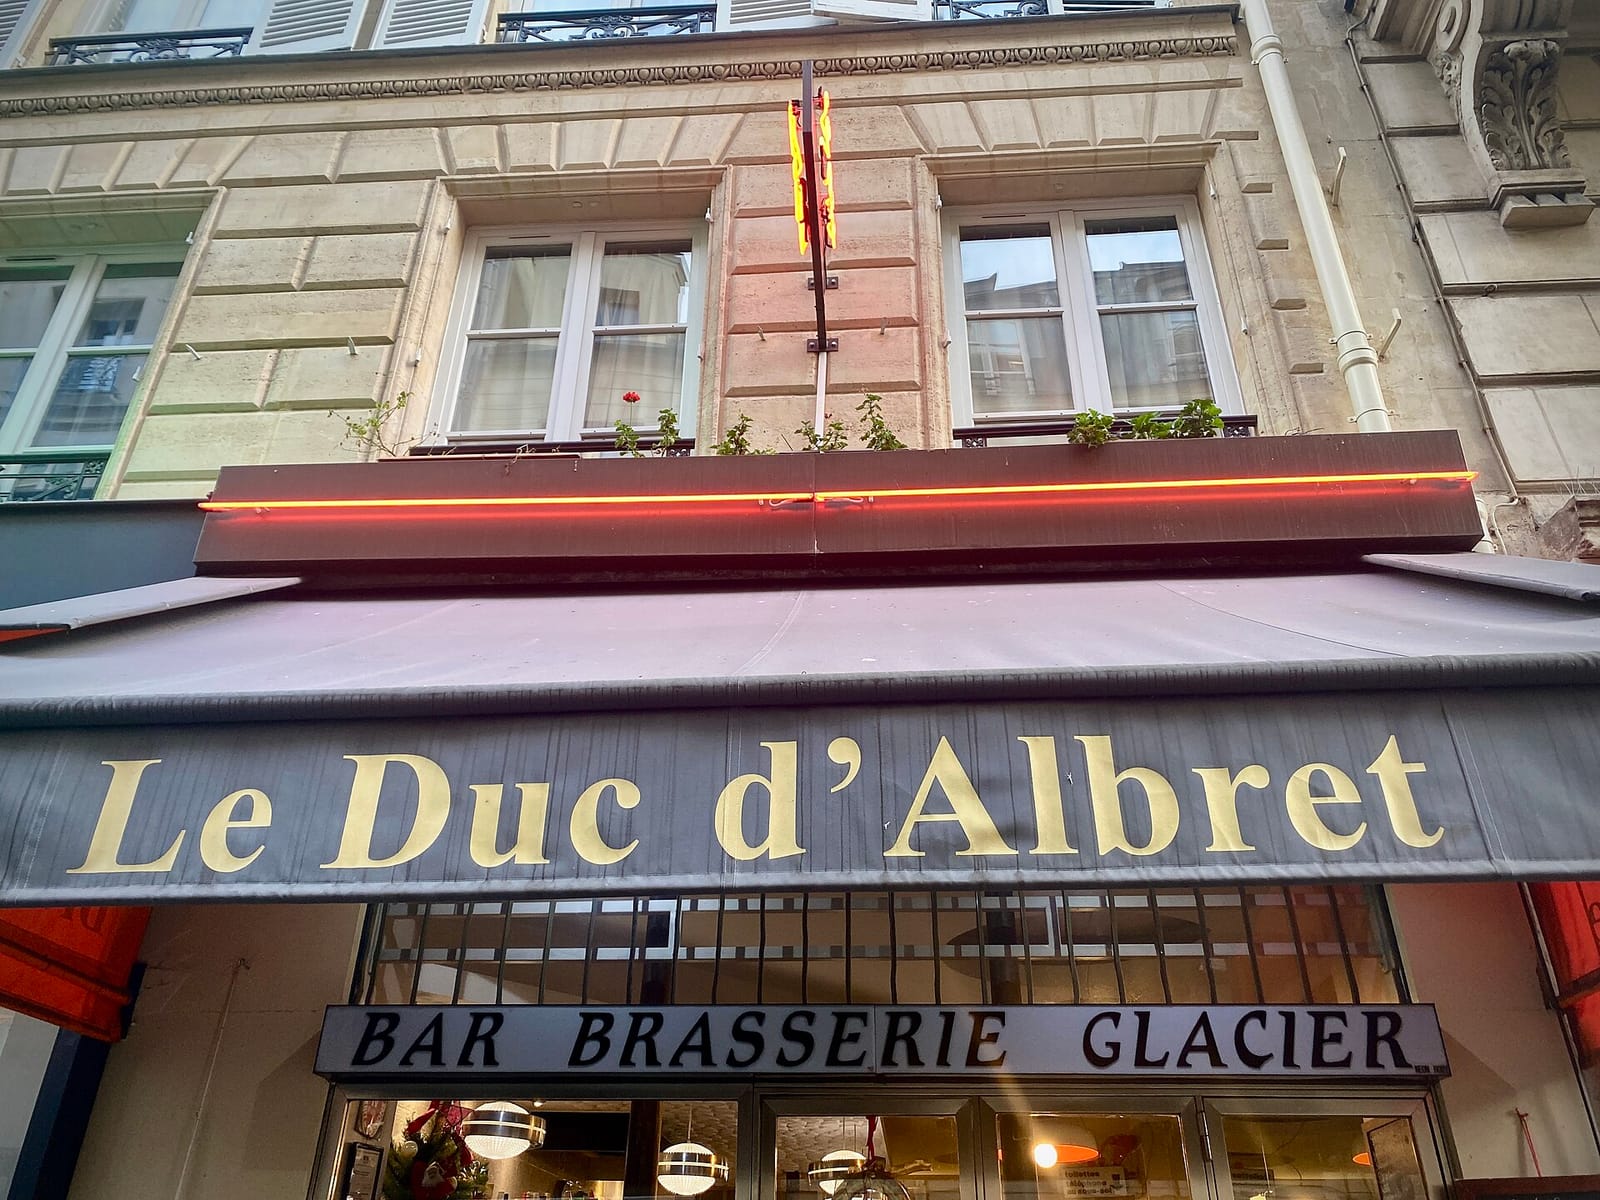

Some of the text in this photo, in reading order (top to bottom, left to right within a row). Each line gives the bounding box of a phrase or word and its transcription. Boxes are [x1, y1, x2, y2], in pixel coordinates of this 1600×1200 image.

[66, 758, 273, 875] Le
[319, 753, 641, 869] Duc
[350, 1009, 1413, 1069] BAR BRASSERIE GLACIER
